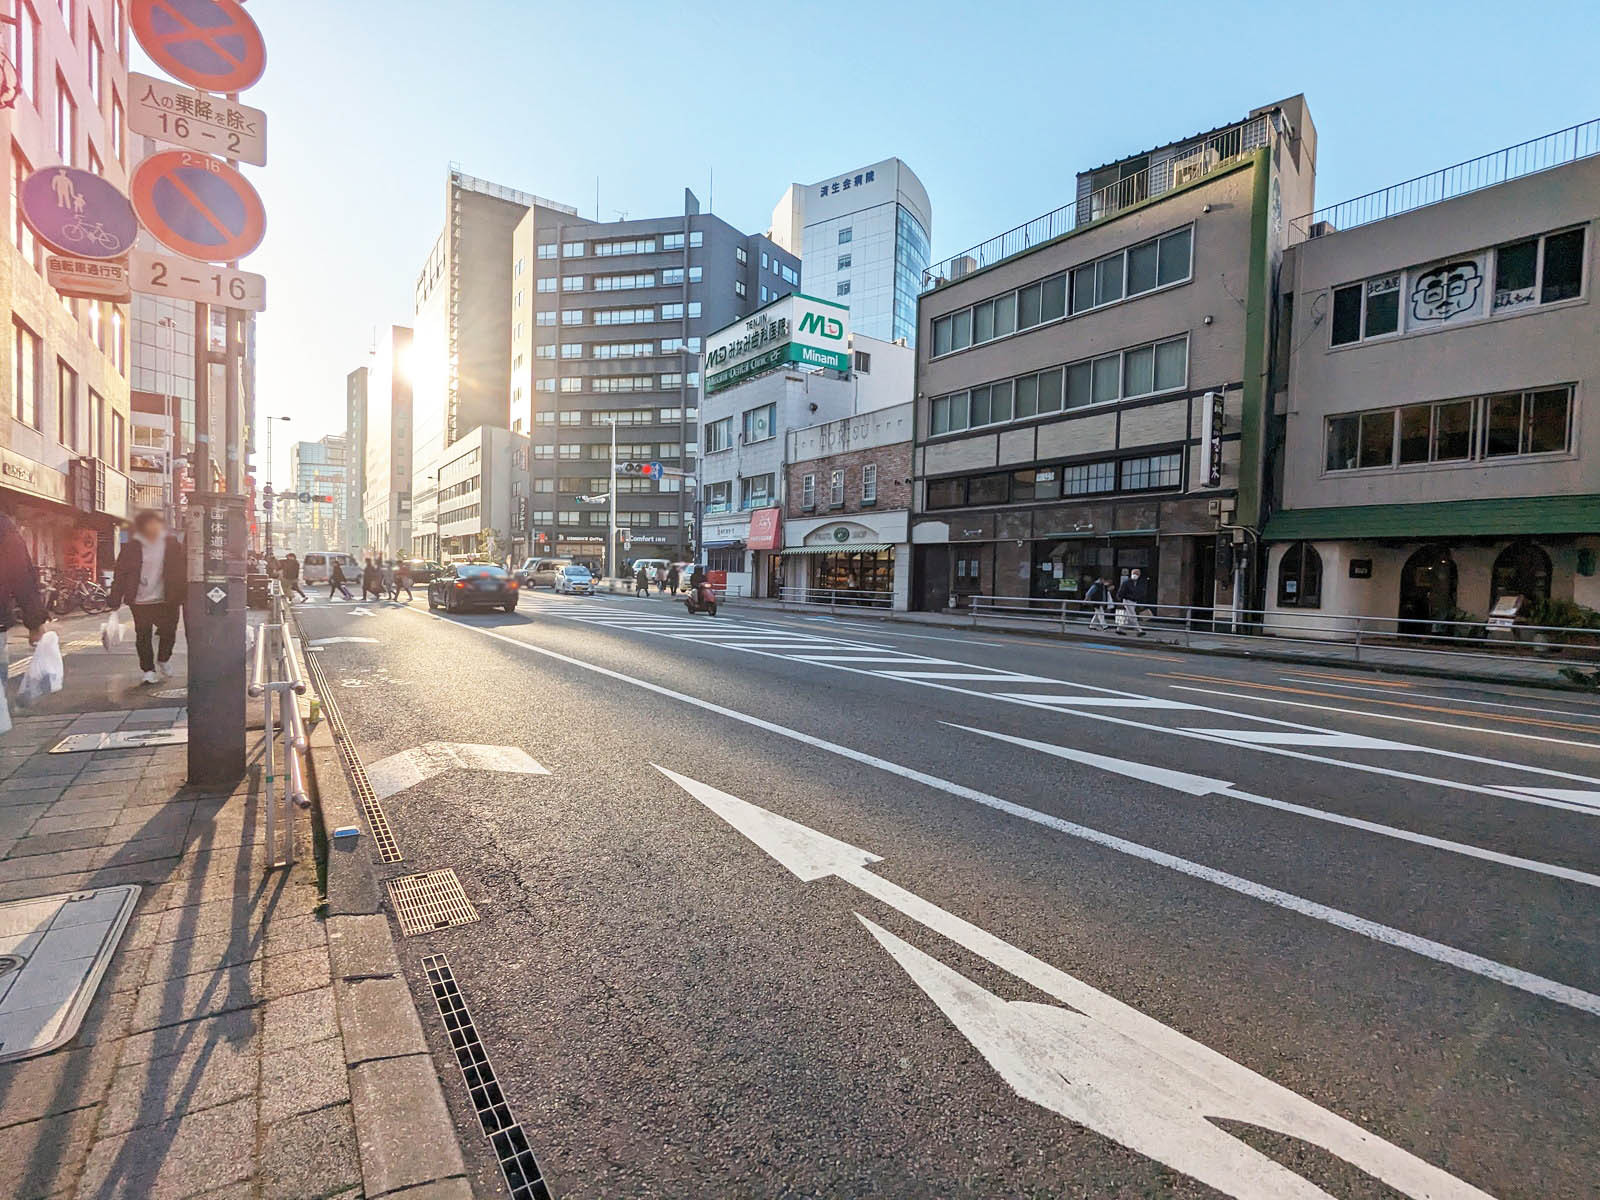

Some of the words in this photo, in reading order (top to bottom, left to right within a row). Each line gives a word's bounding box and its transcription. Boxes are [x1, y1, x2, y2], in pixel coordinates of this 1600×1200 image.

[140, 84, 256, 134] 人の乗降を除く
[820, 170, 875, 198] 済生会病院
[49, 259, 122, 278] 自転車通行可
[745, 312, 768, 332] TENJIN
[802, 348, 839, 366] Minami
